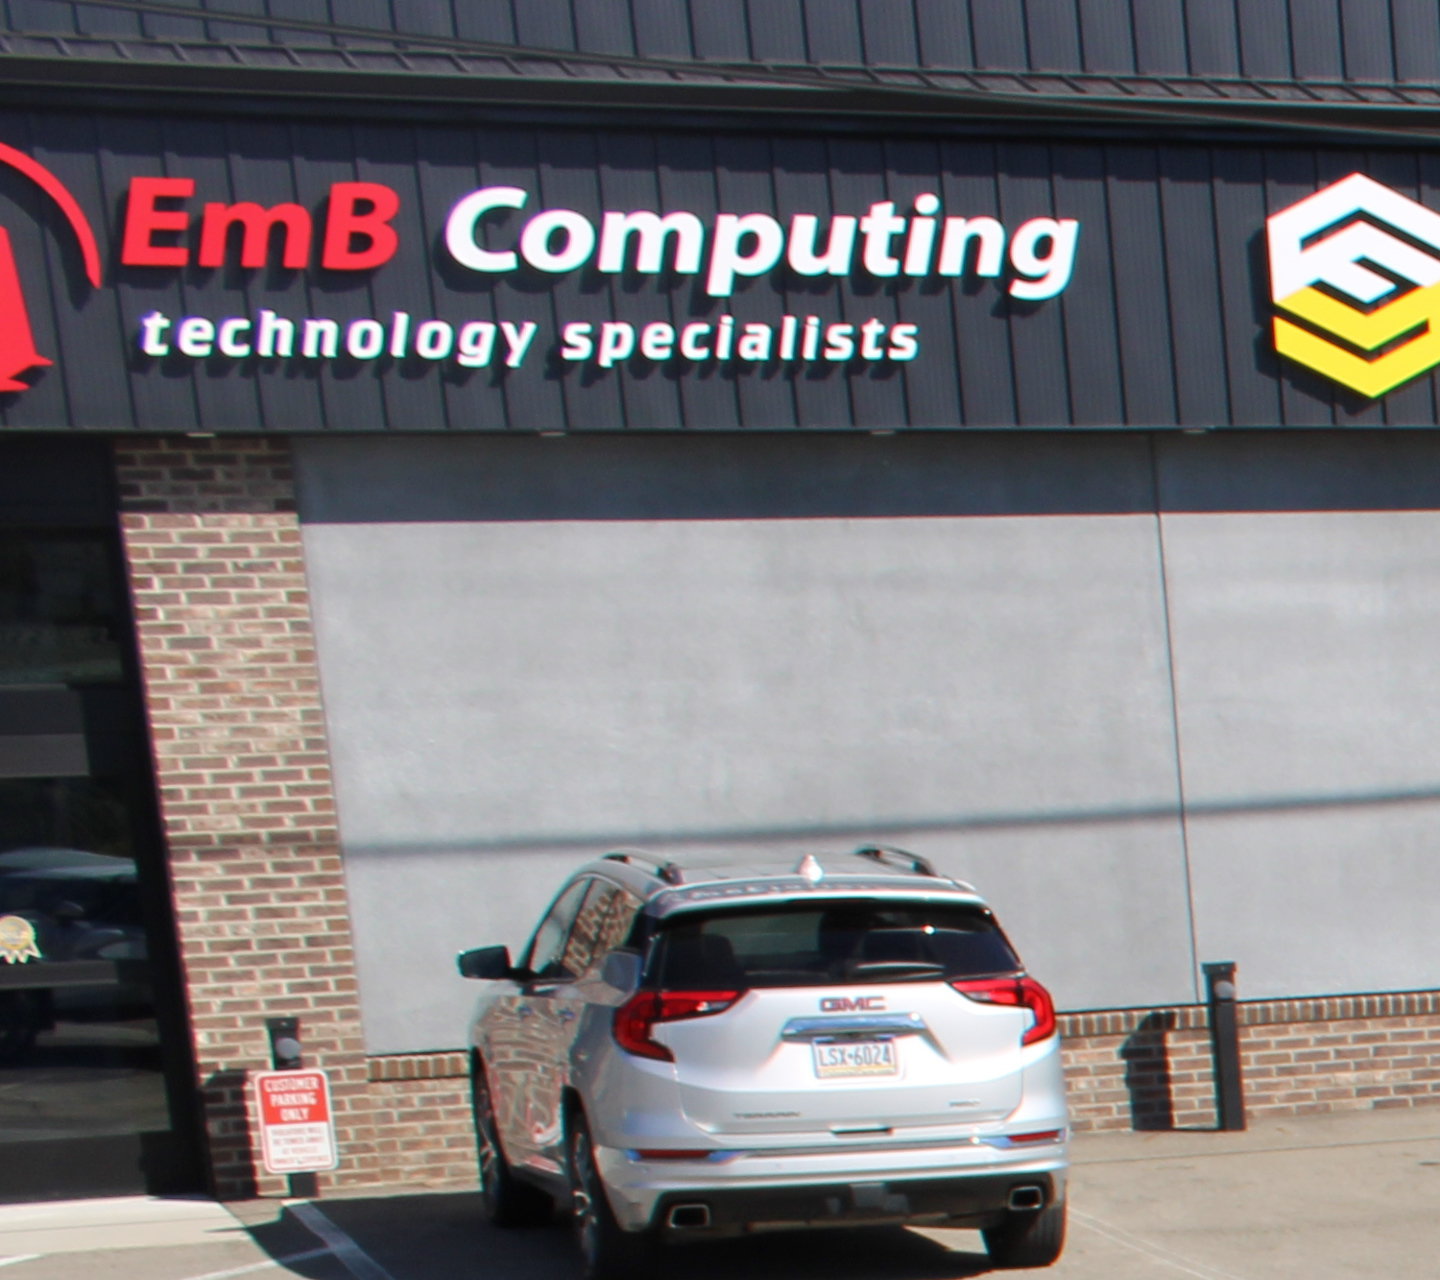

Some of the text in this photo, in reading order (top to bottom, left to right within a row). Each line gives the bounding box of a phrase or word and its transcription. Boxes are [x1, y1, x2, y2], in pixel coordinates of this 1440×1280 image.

[120, 177, 1079, 301] EmB Computing
[140, 311, 919, 369] technology specialists
[820, 996, 886, 1012] GMC
[263, 1077, 319, 1093] CUSTOMER
[270, 1091, 317, 1107] PARKING
[280, 1107, 310, 1122] ONLY
